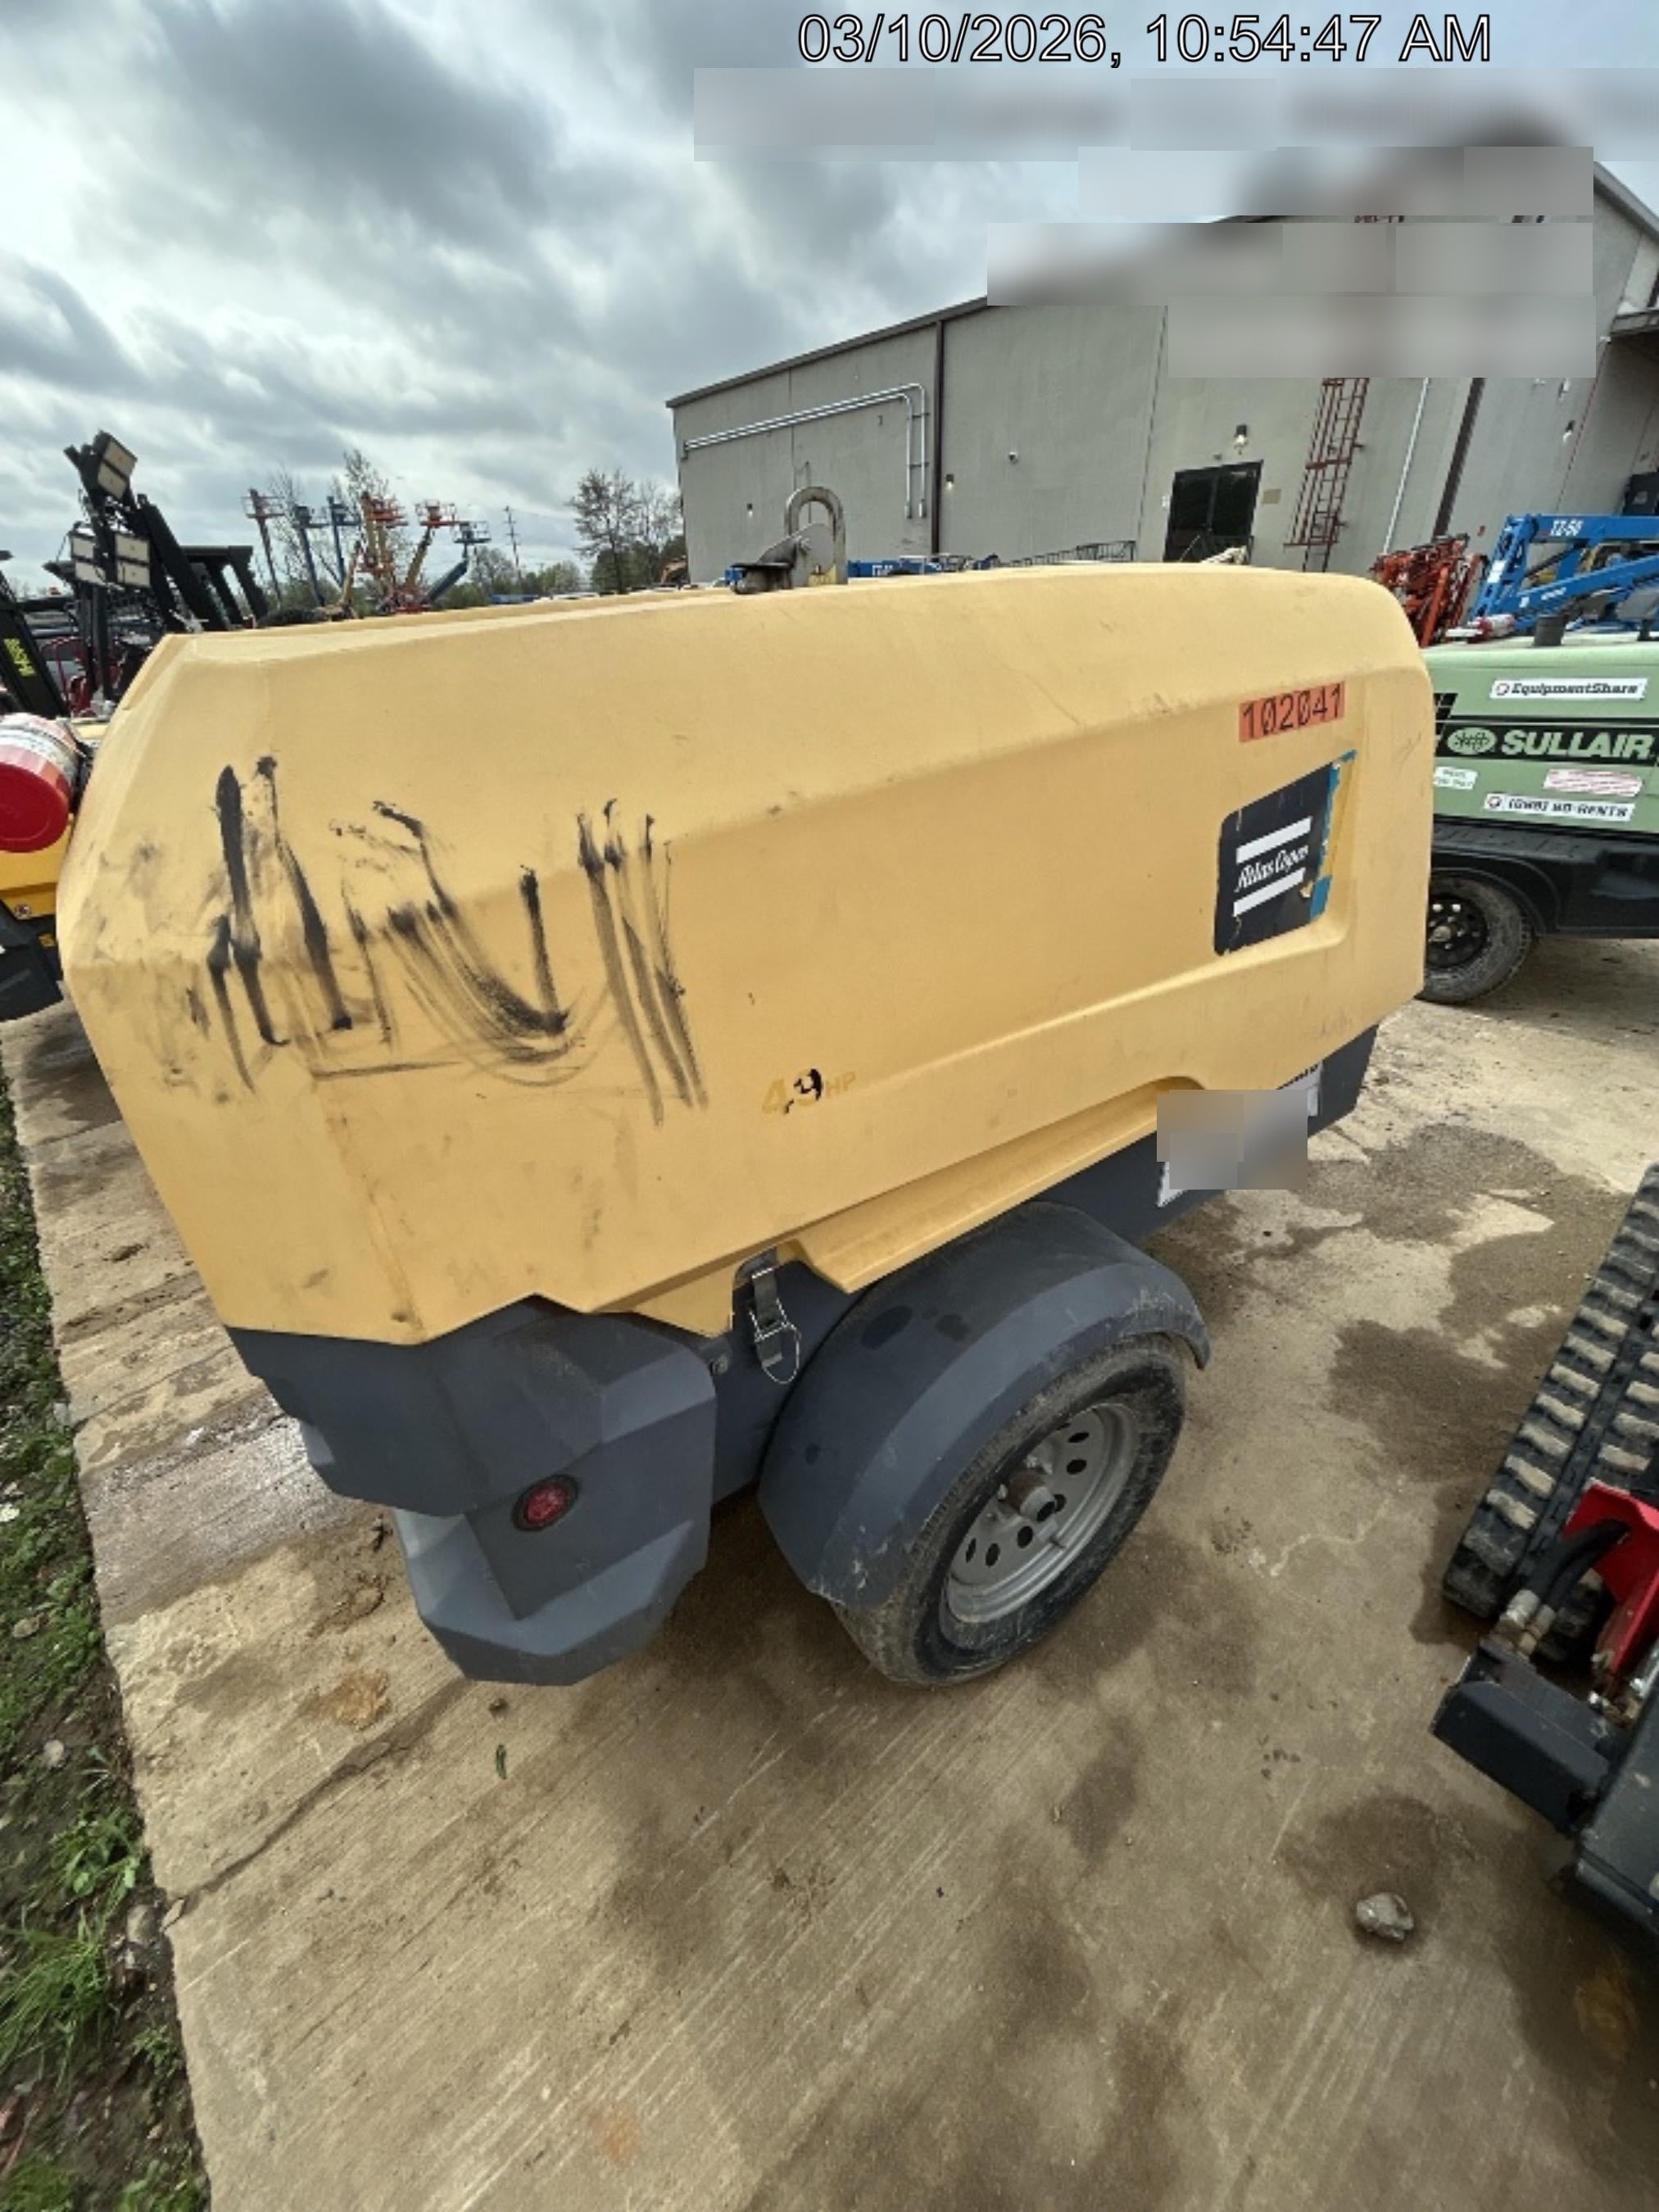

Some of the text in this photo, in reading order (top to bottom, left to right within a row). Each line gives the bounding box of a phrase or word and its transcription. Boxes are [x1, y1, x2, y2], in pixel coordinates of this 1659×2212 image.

[1512, 682, 1638, 696] EquipmentShare
[1243, 683, 1341, 739] 102041
[1502, 729, 1654, 759] SULLAIR
[1234, 845, 1309, 893] Atlas Copco
